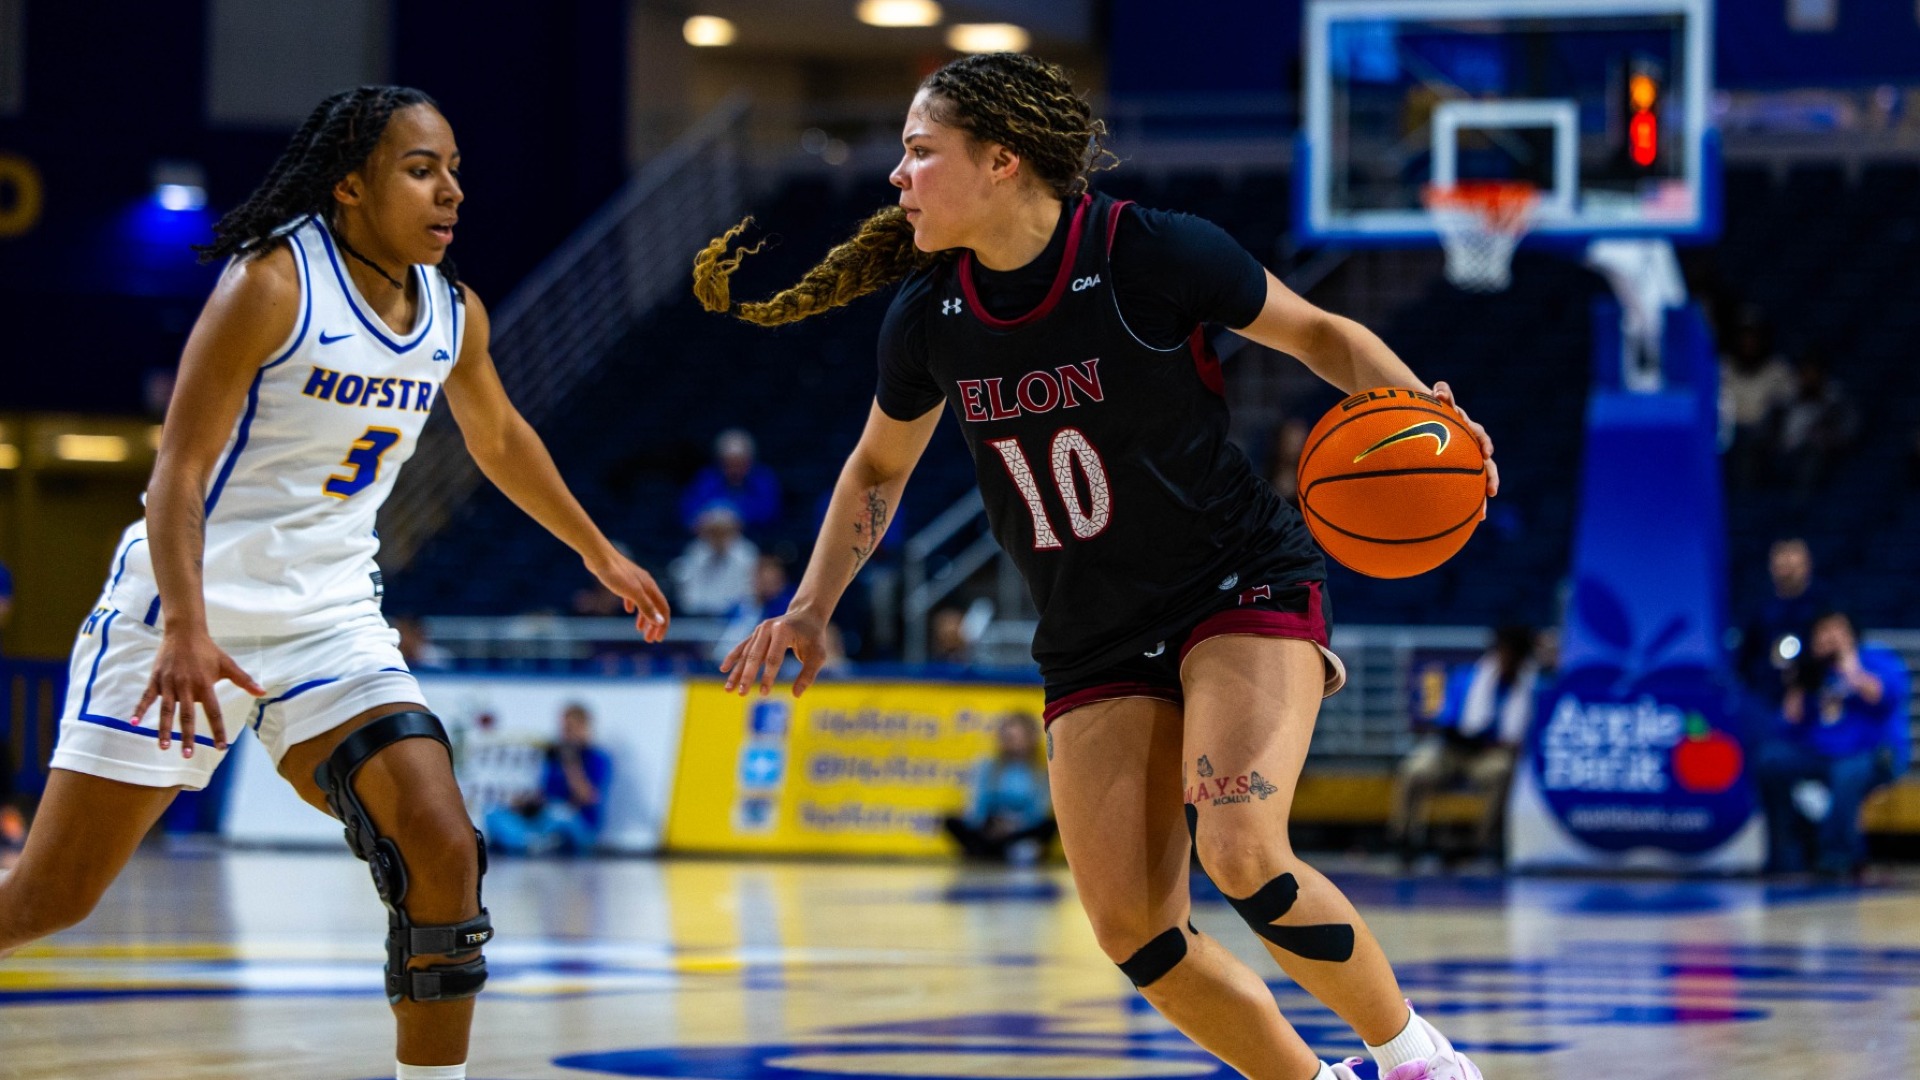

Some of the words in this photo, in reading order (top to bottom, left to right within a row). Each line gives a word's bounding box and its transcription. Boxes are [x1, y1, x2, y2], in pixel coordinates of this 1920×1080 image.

[1072, 274, 1101, 292] CAA
[956, 357, 1104, 422] ELON
[322, 425, 402, 500] 3
[984, 426, 1114, 550] 10
